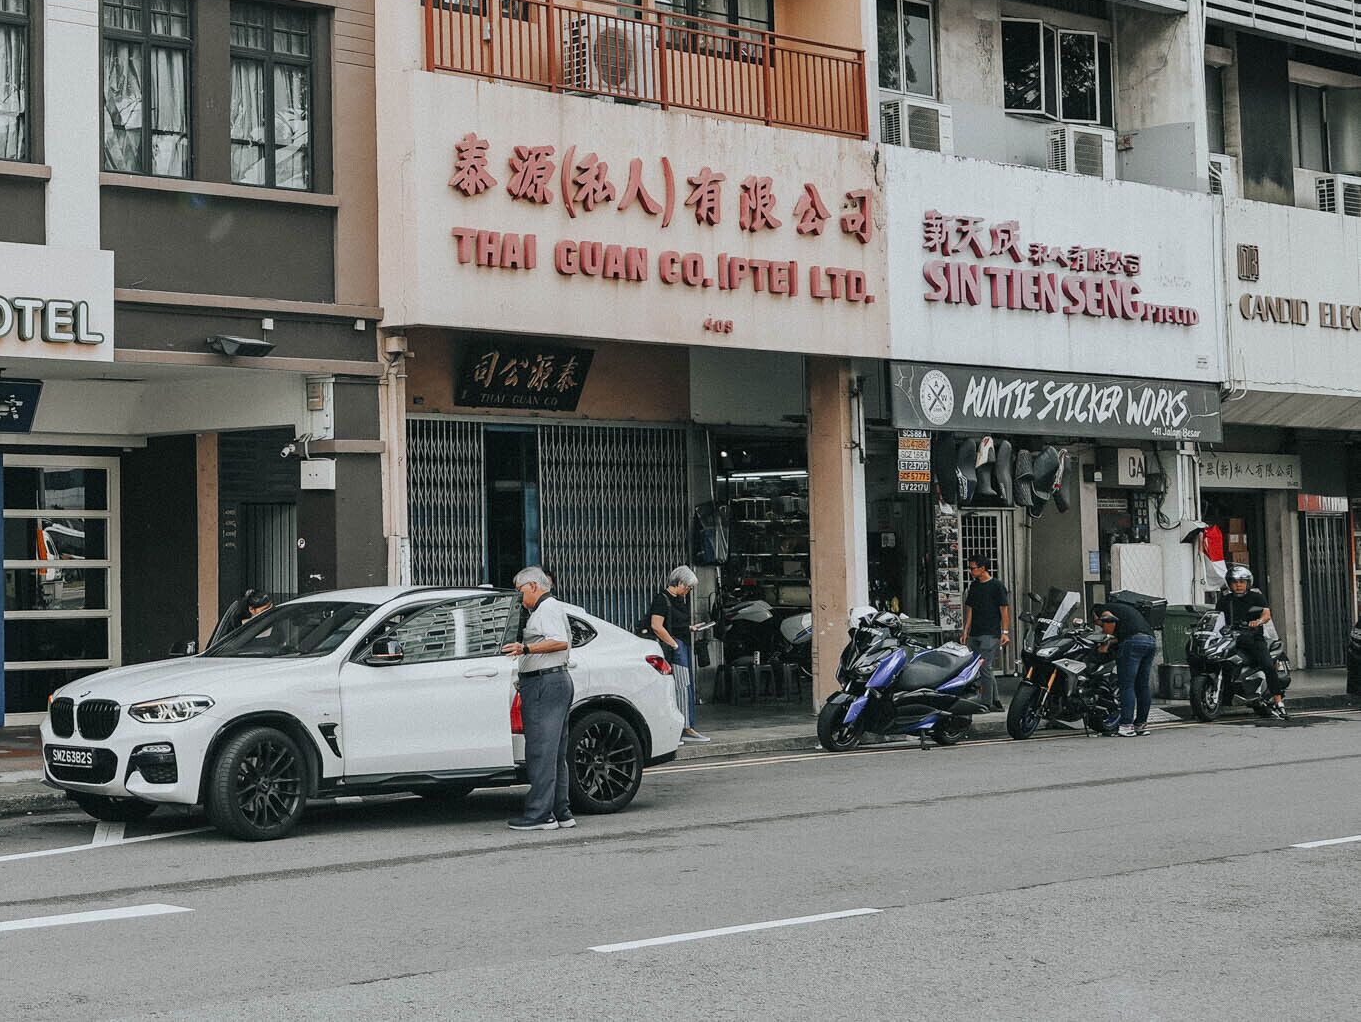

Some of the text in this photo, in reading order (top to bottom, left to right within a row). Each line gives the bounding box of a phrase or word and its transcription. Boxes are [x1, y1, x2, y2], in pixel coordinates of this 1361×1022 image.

[448, 132, 873, 244] 泰源(私人)有限公司
[451, 226, 536, 270] THAI
[554, 239, 648, 282] GUAN
[659, 250, 714, 287] CO.
[810, 265, 875, 304] LTD.
[922, 260, 982, 307] SIN
[984, 265, 1059, 313] TIEN
[1061, 276, 1145, 321] SENG
[1239, 293, 1310, 326] CANDID
[962, 376, 1039, 420] AUNTIE
[1036, 380, 1124, 425] STICKER
[1125, 386, 1189, 428] WORKS
[1182, 428, 1202, 439] Besar
[52, 748, 93, 765] SMZ6382S
